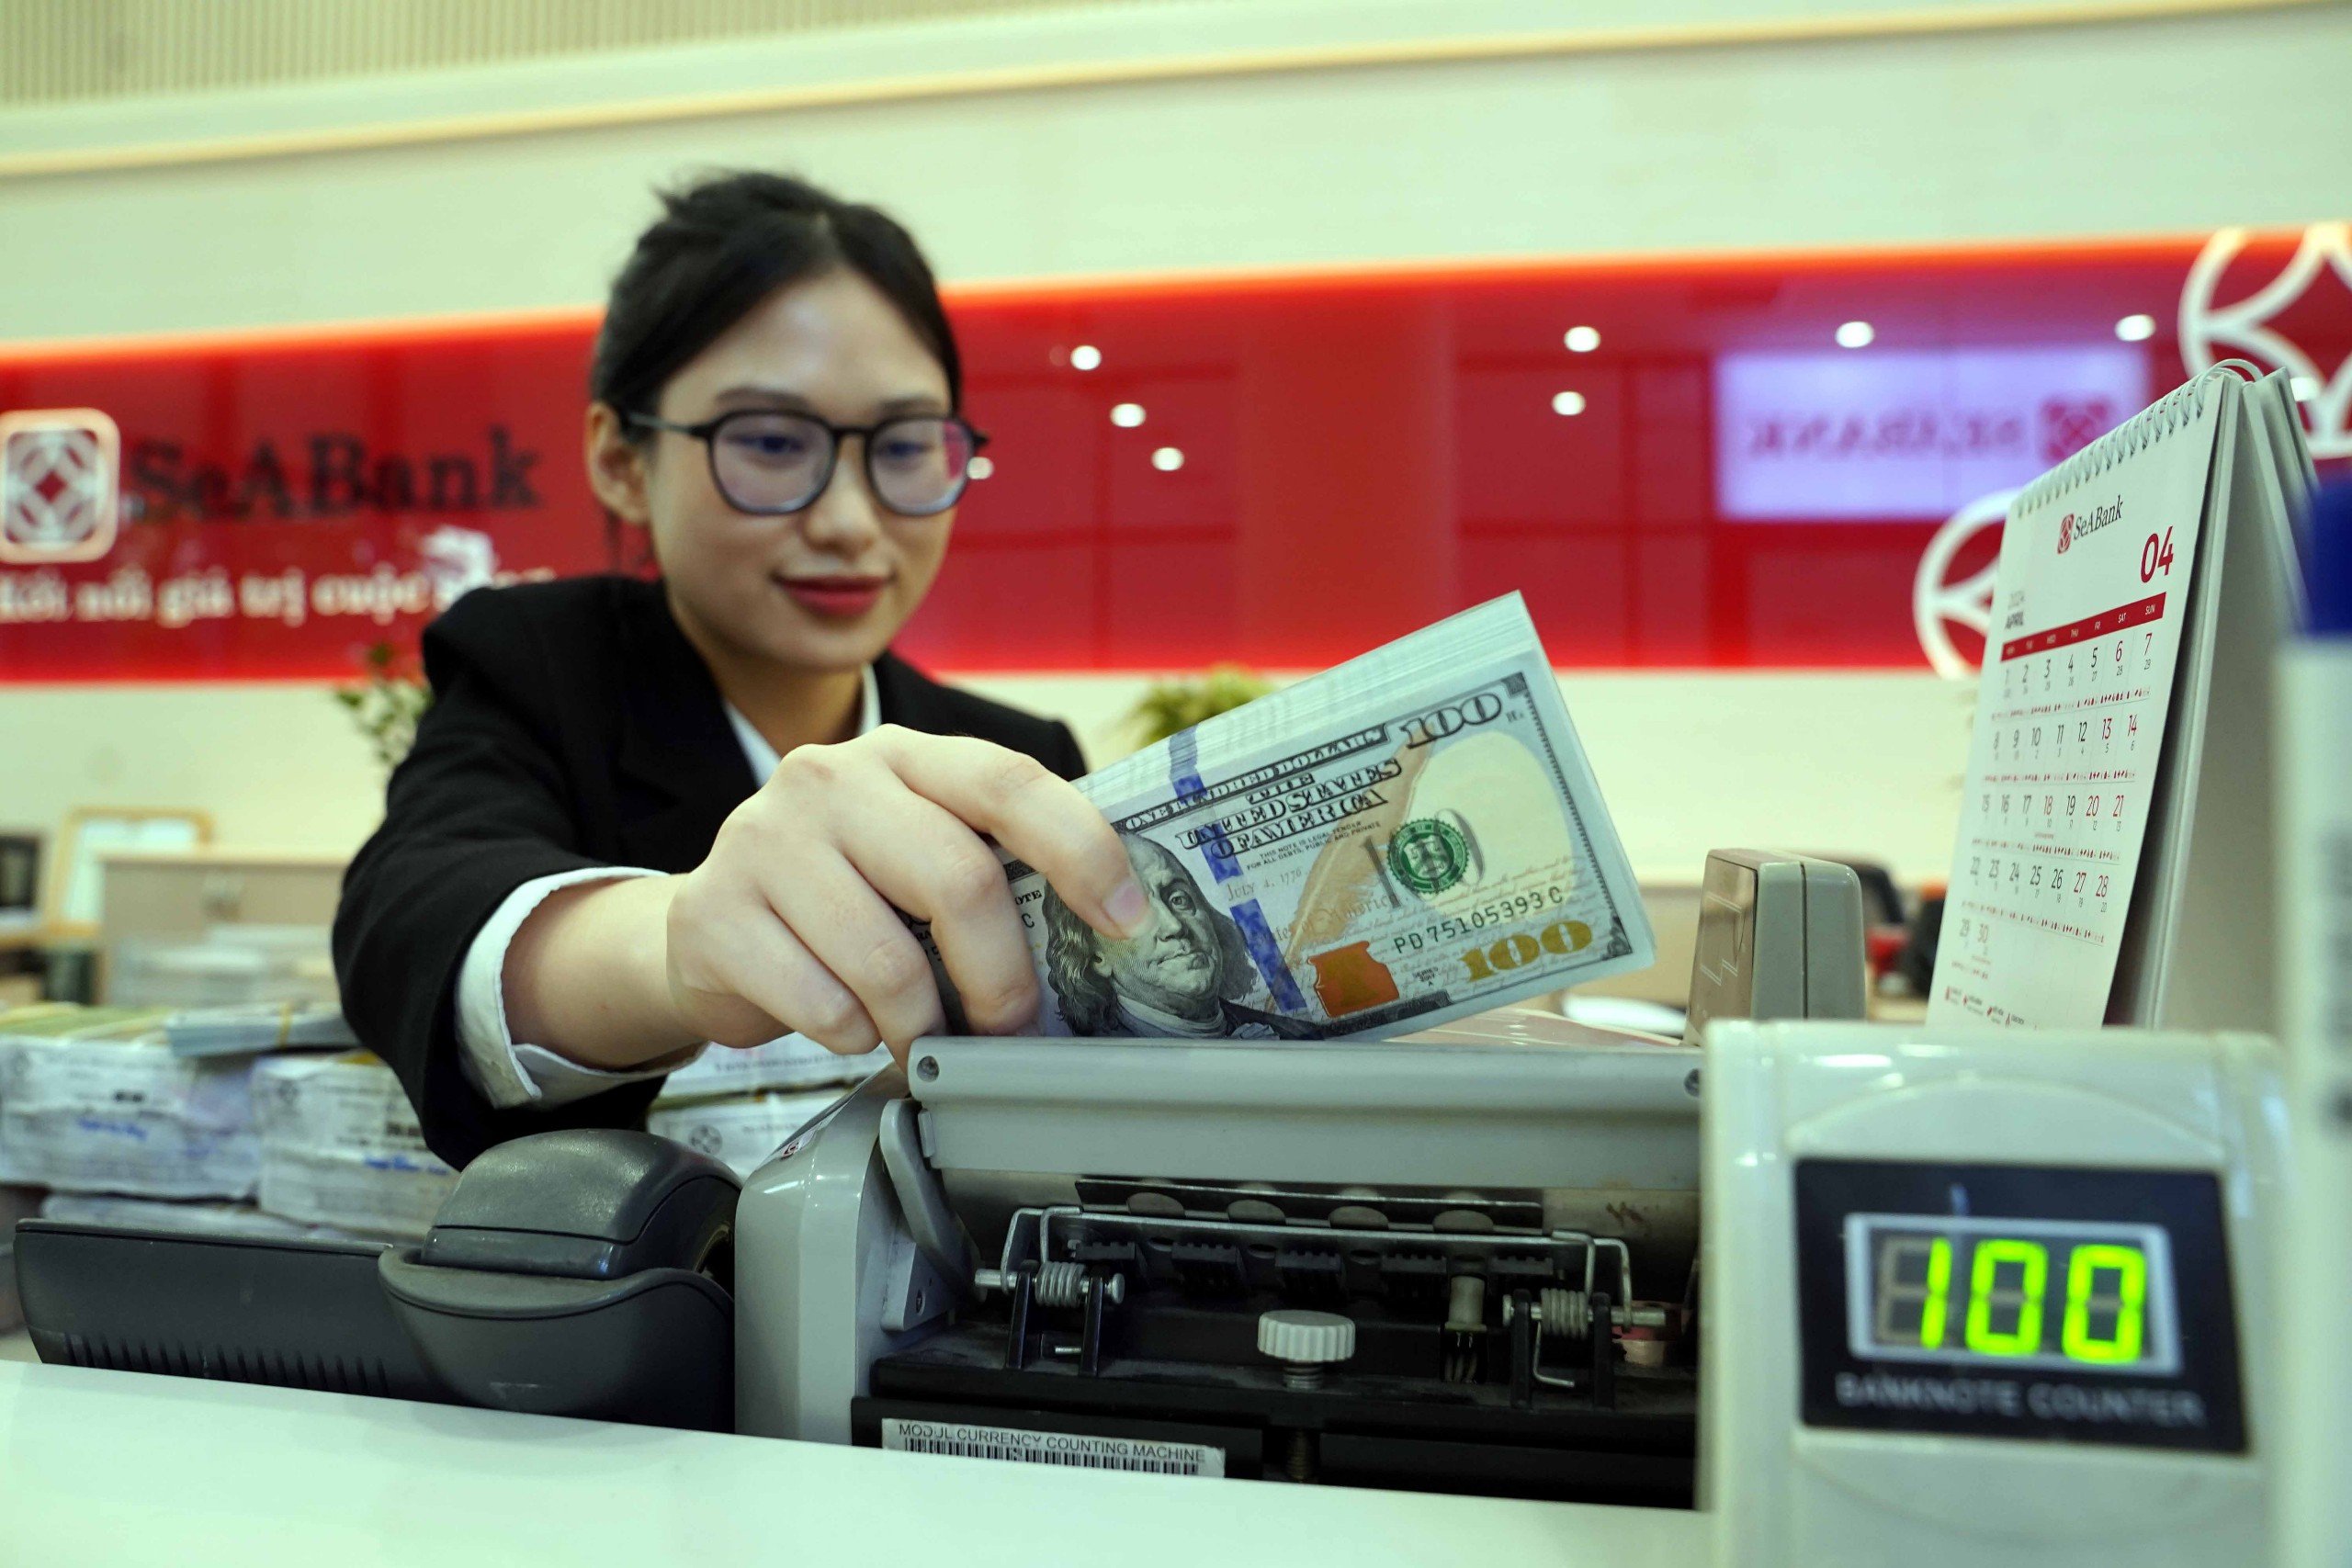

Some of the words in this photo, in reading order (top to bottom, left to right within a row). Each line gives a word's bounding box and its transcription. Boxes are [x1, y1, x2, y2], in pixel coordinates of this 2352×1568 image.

[130, 425, 543, 523] SeABank
[2074, 494, 2124, 540] SeABank
[2140, 525, 2174, 584] 04
[2118, 612, 2127, 624] SAT
[2144, 604, 2156, 615] SUN
[2022, 664, 2029, 683] 2
[2044, 659, 2052, 679] 3
[2068, 653, 2074, 673] 4
[2090, 647, 2098, 668] 5
[2115, 640, 2123, 662] 6
[2143, 632, 2153, 656] 7
[1398, 693, 1502, 750] 100
[2013, 729, 2020, 749] 9
[2031, 727, 2041, 747] 10
[2057, 724, 2064, 744] 11
[2078, 721, 2087, 742] 12
[2101, 717, 2112, 740] 13
[2127, 713, 2138, 737] 14
[1125, 802, 1172, 829] ONE
[1175, 798, 1286, 850] UNITED
[1286, 759, 1402, 813] STATES
[1211, 834, 1251, 859] OF
[1250, 789, 1389, 851] AMERICA
[2023, 794, 2031, 815] 17
[2043, 795, 2053, 816] 18
[2066, 795, 2076, 816] 19
[2086, 795, 2099, 818] 20
[2112, 795, 2124, 818] 21
[1247, 861, 1262, 871] FOR
[1263, 856, 1278, 865] ALL
[1260, 850, 1276, 860] THIS
[1014, 889, 1043, 906] OTE
[2008, 862, 2020, 882] 24
[2030, 864, 2042, 886] 25
[2051, 868, 2064, 890] 26
[2074, 872, 2086, 894] 27
[2095, 874, 2109, 898] 28
[1459, 919, 1593, 982] 100
[1921, 1236, 2147, 1365] 100
[1836, 1373, 2019, 1418] BANKNOTE
[2027, 1386, 2203, 1428] COUNTER
[956, 1427, 1042, 1448] CURRENCY
[1046, 1436, 1128, 1455] COUNTING
[1133, 1443, 1206, 1462] MACHINE
